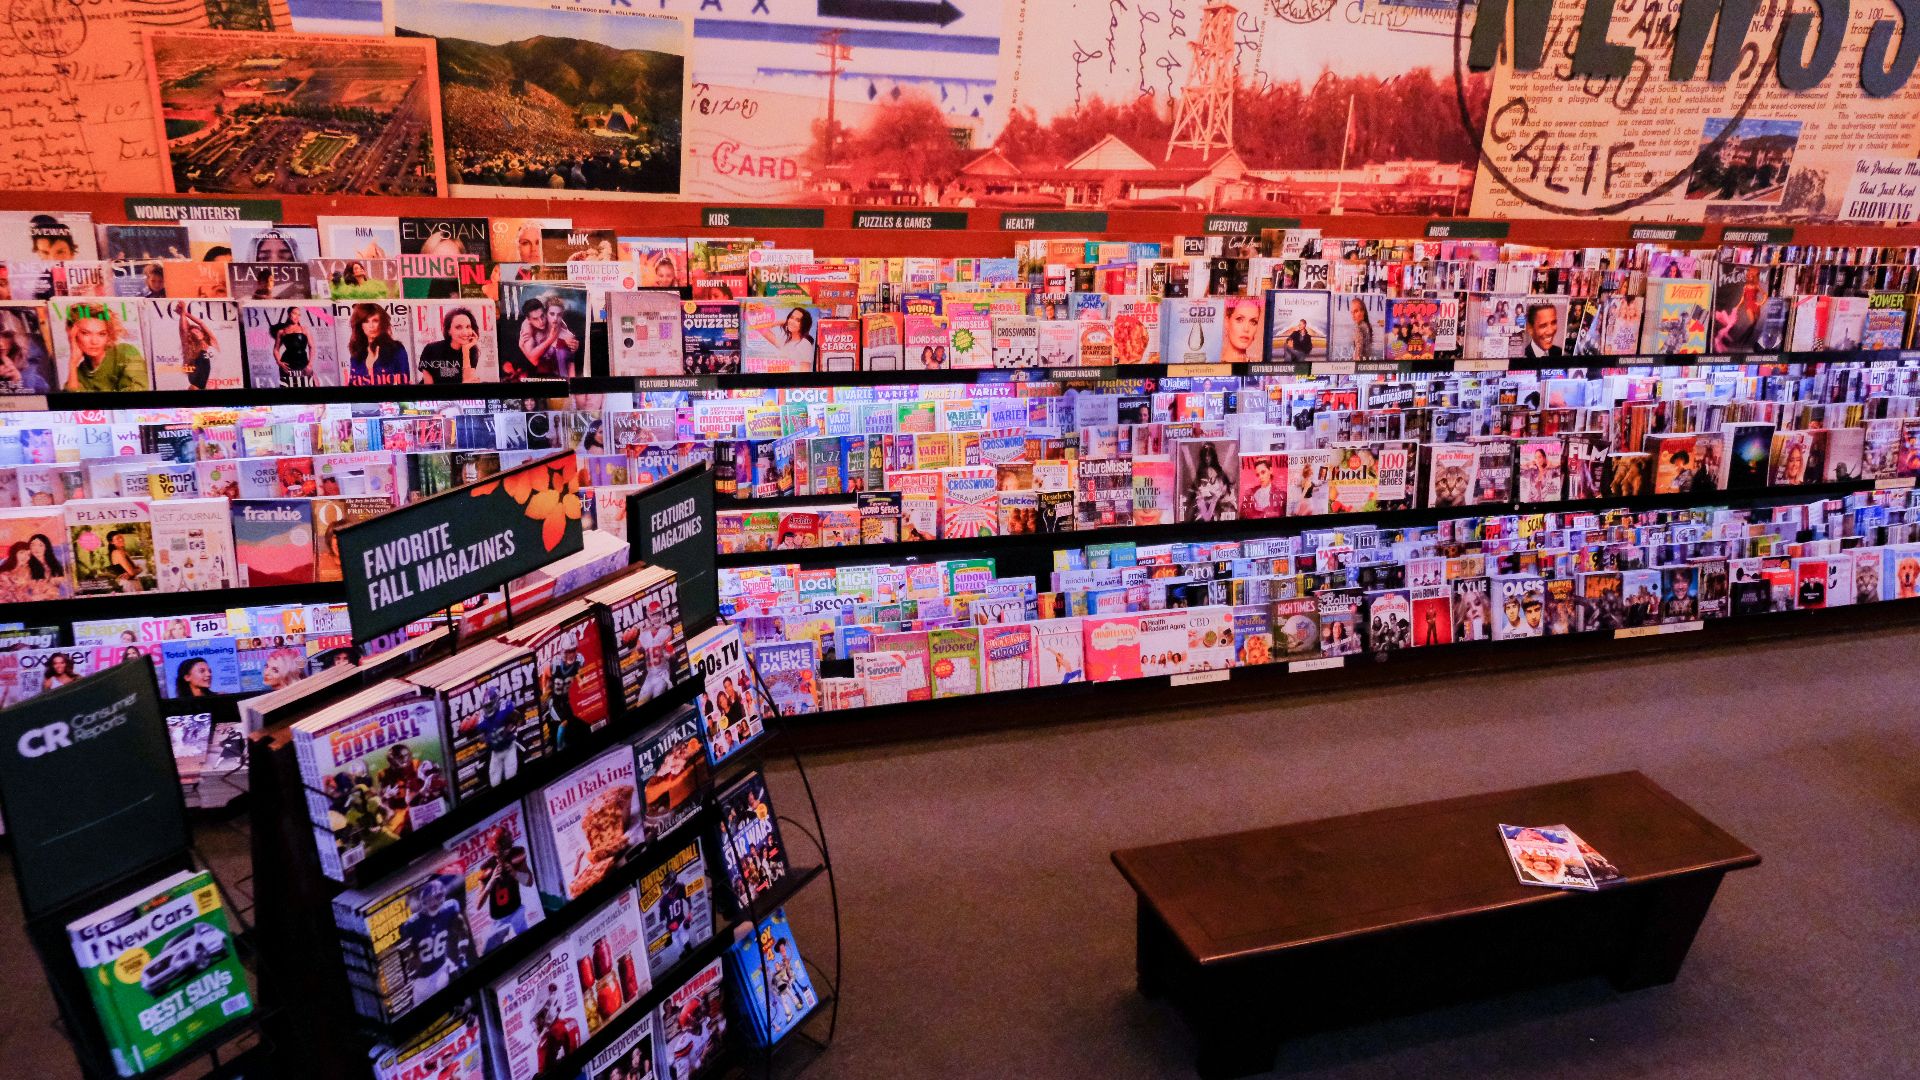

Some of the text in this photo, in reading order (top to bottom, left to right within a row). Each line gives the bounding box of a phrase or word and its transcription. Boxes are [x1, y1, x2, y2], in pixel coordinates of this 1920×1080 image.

[1533, 83, 1564, 93] together
[1567, 83, 1582, 91] late
[1657, 85, 1709, 94] South Chicago
[1568, 95, 1599, 104] plugged
[1684, 95, 1725, 103] established
[1558, 130, 1576, 138] those
[1642, 128, 1670, 136] downed
[711, 141, 798, 182] CARD
[1870, 160, 1902, 176] Produce
[1877, 182, 1895, 197] Just
[1897, 183, 1916, 197] Kept
[134, 205, 241, 220] WOMEN'S INTEREST
[1849, 201, 1912, 220] GROWING
[709, 214, 729, 226] KIDS
[859, 216, 931, 228] PUZZLES & GAMES
[1006, 218, 1034, 230] HEALTH
[1209, 220, 1248, 232] LIFESTYLES
[355, 227, 373, 238] RIKA
[402, 222, 485, 240] ELYSIAN
[1429, 227, 1449, 237] MUSIC
[1749, 232, 1768, 242] EVENTS
[697, 279, 743, 288] BRIGHT LITE
[1671, 285, 1705, 299] VARIETY
[1869, 294, 1904, 307] POWER
[1134, 303, 1158, 313] BEAT
[1189, 307, 1216, 317] CBD
[684, 318, 739, 330] QUIZZES
[998, 328, 1036, 337] CROSSWORDS
[1379, 363, 1398, 371] MAGAZINE
[1052, 369, 1101, 378] FEATURED MAGAZINE
[640, 378, 698, 388] FEATURED MAGAZINE
[969, 387, 1011, 396] VARIETY
[1368, 390, 1413, 406] STRATOCASTER
[700, 424, 731, 432] WORLD
[982, 439, 1024, 450] CROSSWORD
[328, 456, 379, 466] REAL SIMPLE
[1299, 455, 1330, 464] SNAPSHOT
[1381, 453, 1404, 468] 100
[1436, 452, 1474, 461] Cat's Mind
[1079, 461, 1131, 476] FutureMusic
[1380, 469, 1404, 478] GUITAR
[948, 479, 995, 491] CROSSWORD
[1379, 478, 1403, 486] HEROES
[161, 484, 188, 493] Your
[1002, 496, 1038, 507] Chicken
[1138, 500, 1157, 508] MIND
[77, 509, 138, 522] PLANTS
[178, 511, 223, 522] JOURNAL
[243, 506, 302, 522] frankie
[651, 497, 695, 532] FEATURED
[652, 516, 702, 554] MAGAZINES
[363, 522, 453, 580] FAVORITE
[367, 529, 516, 611] FALL MAGAZINES
[955, 573, 991, 582] SUDOKU
[743, 580, 772, 593] Science
[955, 582, 986, 590] PUZZLES
[1457, 580, 1487, 593] KYLIE
[1503, 580, 1544, 596] OASIS
[1327, 590, 1363, 606] Rolling
[1423, 587, 1440, 598] BOWIE
[1278, 601, 1315, 615] HIGH TIMES
[1169, 623, 1186, 632] Aging
[1190, 617, 1210, 627] CBD
[165, 646, 235, 659] Total Wellbeing
[721, 639, 739, 666] TV
[933, 641, 977, 653] SUDOKU!
[760, 648, 810, 662] THEME
[761, 660, 812, 673] PARKS
[379, 709, 409, 727] 2019
[17, 692, 138, 758] CR Consumer
[73, 713, 128, 743] Reports
[331, 718, 422, 767] FOOTBALL
[638, 717, 698, 769] PUMPKIN
[549, 760, 633, 818] Fall Baking
[668, 900, 682, 919] 10
[105, 904, 194, 956] New Cars
[578, 902, 632, 947] fermentation
[418, 929, 448, 963] 26
[514, 952, 570, 996] ROTOWORLD
[138, 969, 233, 1031] BEST SUVs
[504, 987, 537, 1016] FANTASY
[590, 1015, 651, 1072] Entrepreneur
